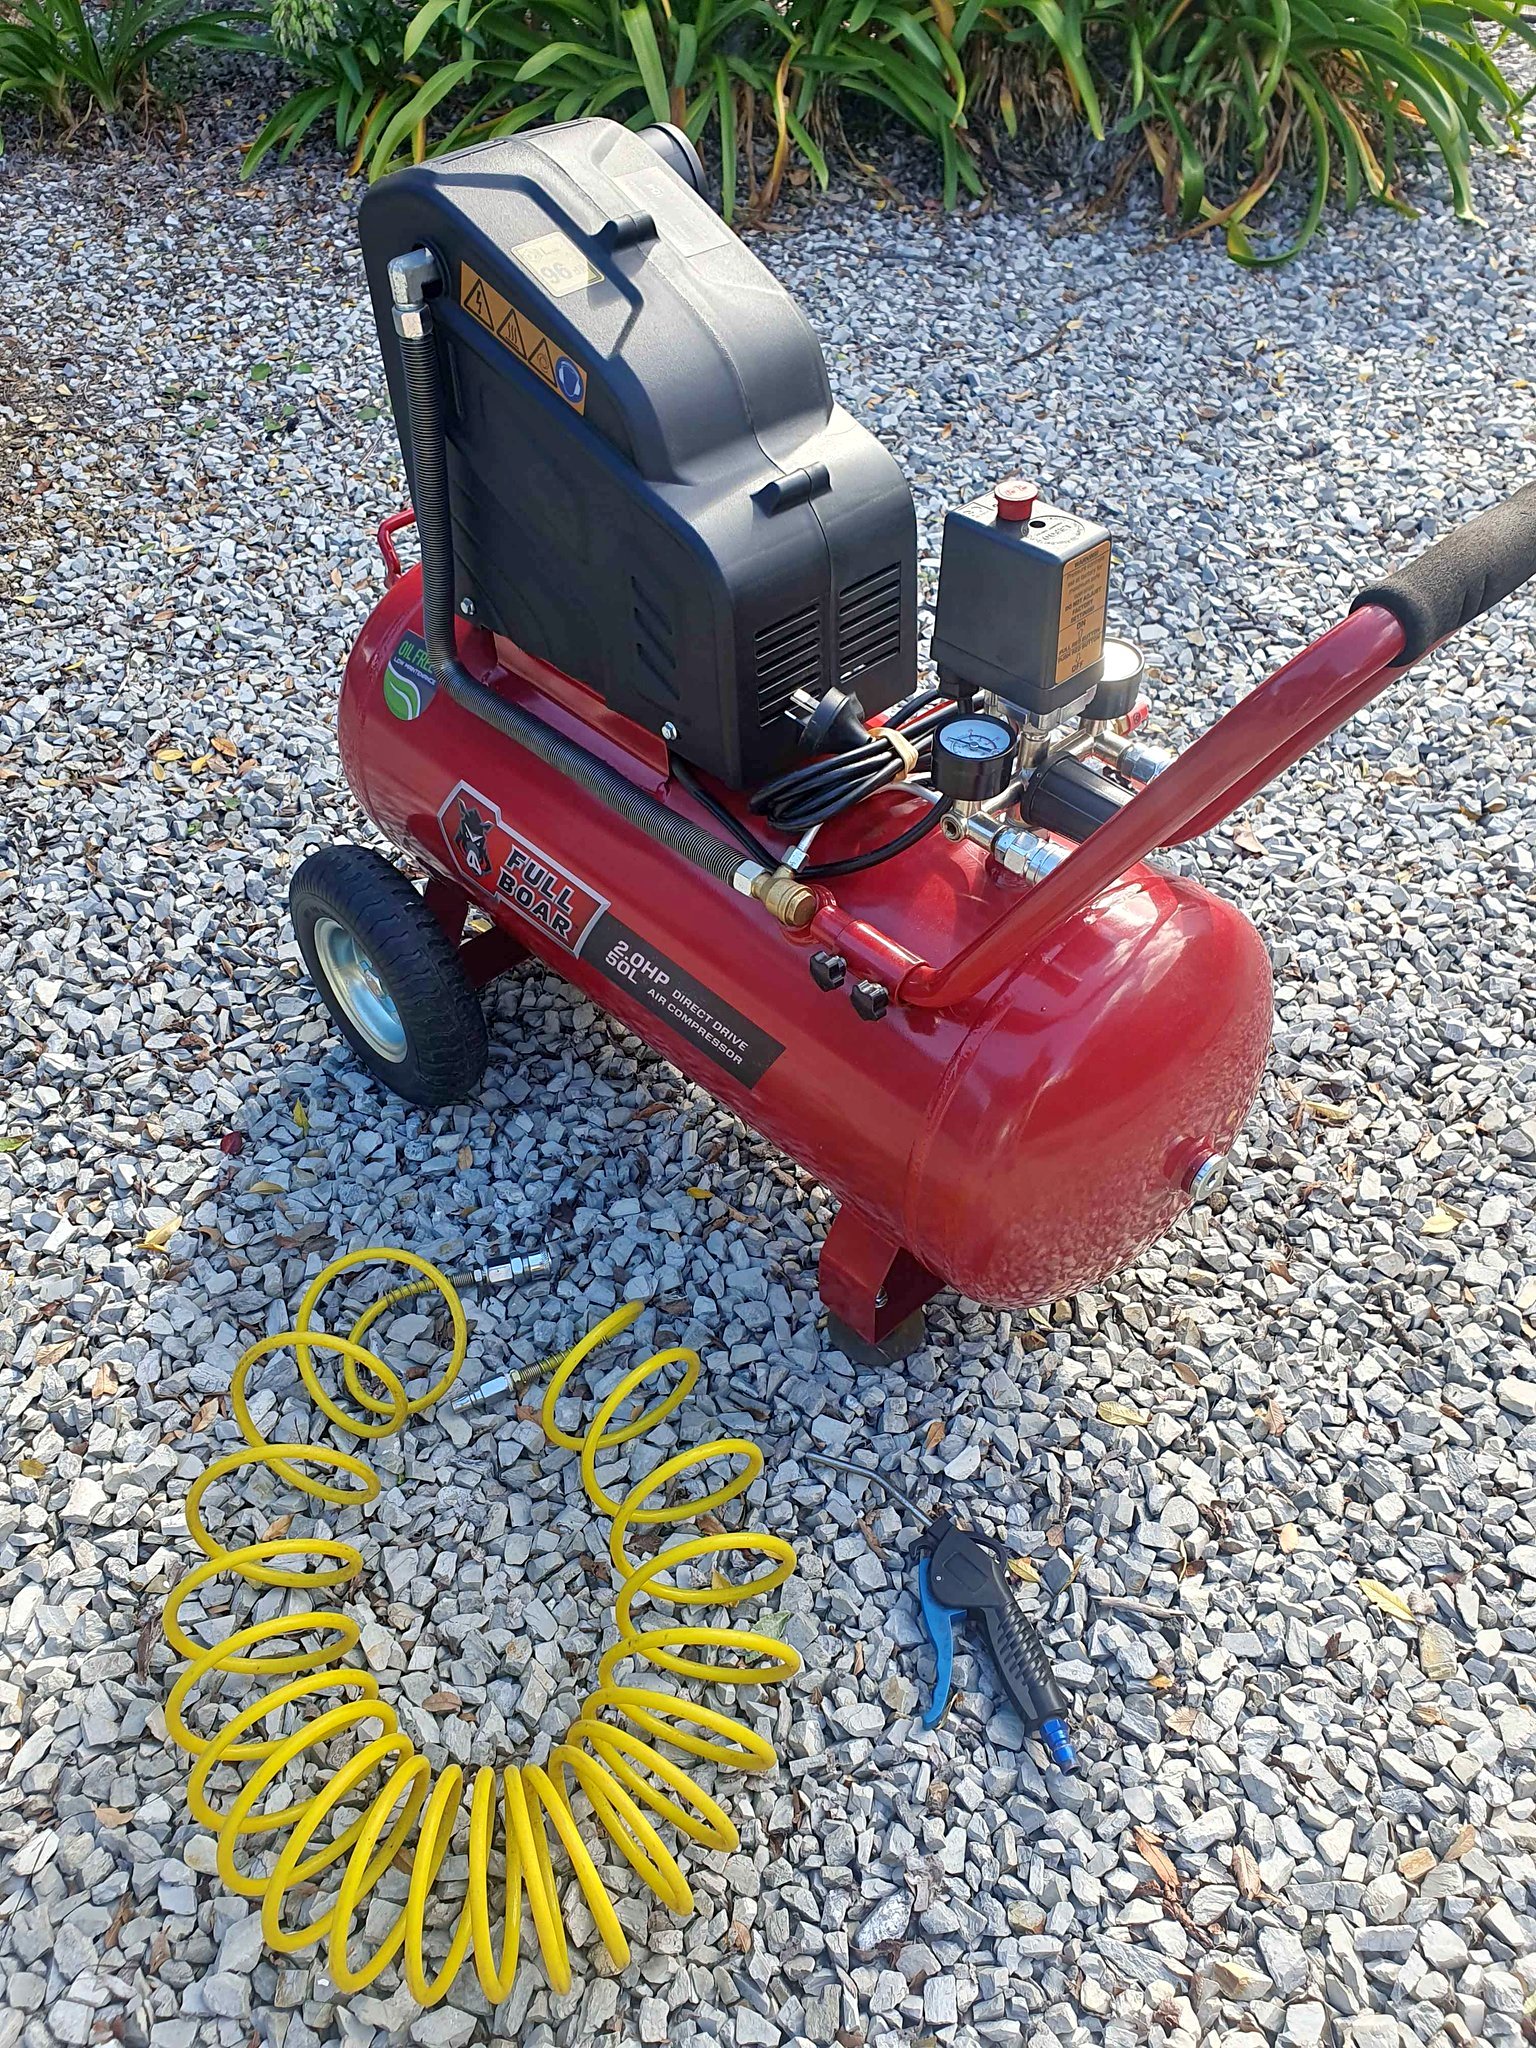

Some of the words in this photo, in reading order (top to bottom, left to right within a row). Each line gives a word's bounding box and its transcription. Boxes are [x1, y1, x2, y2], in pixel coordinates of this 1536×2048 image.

[540, 262, 573, 283] 96
[1072, 598, 1093, 615] FACTORY
[1073, 597, 1083, 607] NOT
[1077, 619, 1086, 630] ON
[398, 640, 415, 661] OIL
[1072, 659, 1084, 673] OFF
[504, 844, 575, 915] FULL
[496, 866, 573, 941] BOAR
[605, 950, 638, 985] 50L
[613, 940, 671, 985] 2.0HP
[647, 988, 667, 1006] AIR
[667, 1003, 744, 1065] COMPRESSOR
[671, 989, 714, 1023] DIRECT
[712, 1021, 749, 1052] DRIVE
